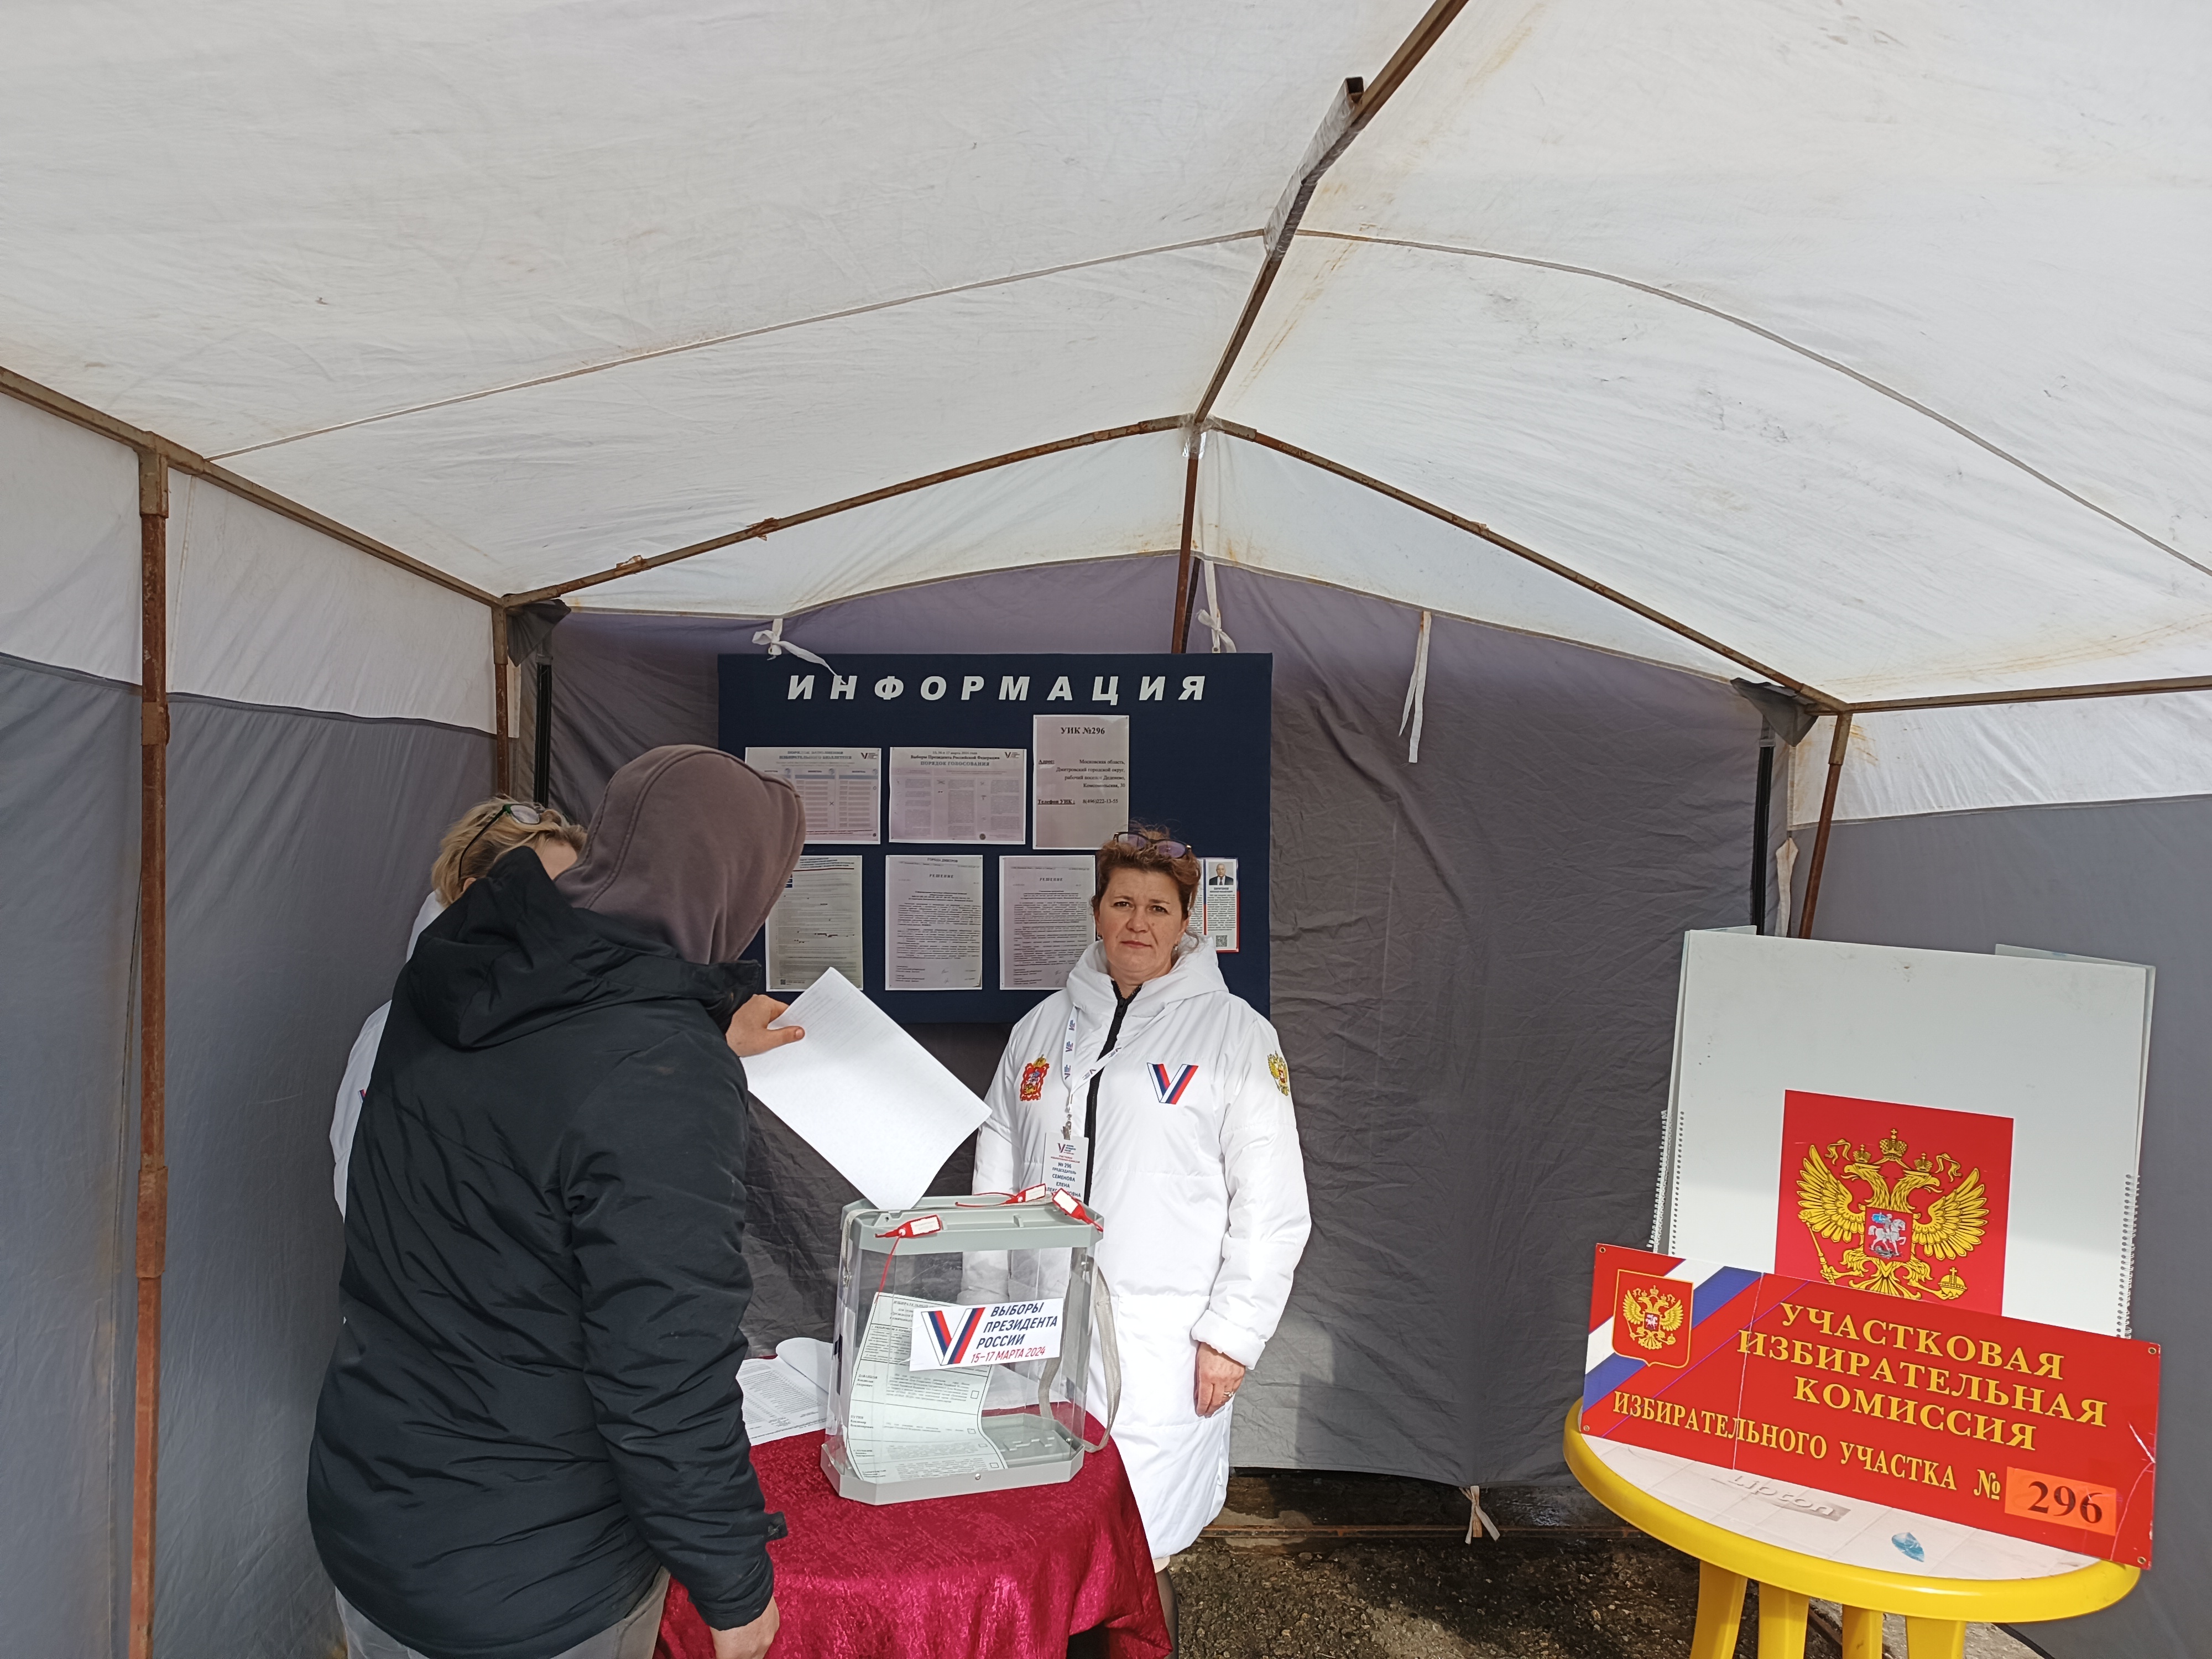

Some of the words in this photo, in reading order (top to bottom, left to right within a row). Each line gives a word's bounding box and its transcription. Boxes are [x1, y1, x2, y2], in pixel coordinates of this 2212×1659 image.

[787, 675, 1206, 706] ИНФОРМАЦИЯ
[1052, 1173, 1076, 1182] СЕМЕНОВА
[990, 1302, 1045, 1317] ВЫБОРЫ
[983, 1316, 1058, 1333] ПРЕЗИДЕНТА
[976, 1334, 1026, 1349] РОССИИ
[1780, 1302, 2064, 1380] УЧАСТКОВАЯ
[995, 1348, 1024, 1361] МАРТА
[1024, 1346, 1046, 1358] 2024
[1736, 1329, 2107, 1427] ИЗБИРАТЕЛЬНАЯ
[1793, 1376, 2037, 1451] КОМИССИЯ
[1613, 1391, 1827, 1459] ИЗБИРАТЕЛЬНОГО
[1840, 1441, 1957, 1490] УЧАСТКА
[1973, 1469, 2001, 1500] №
[2027, 1480, 2104, 1524] 296
